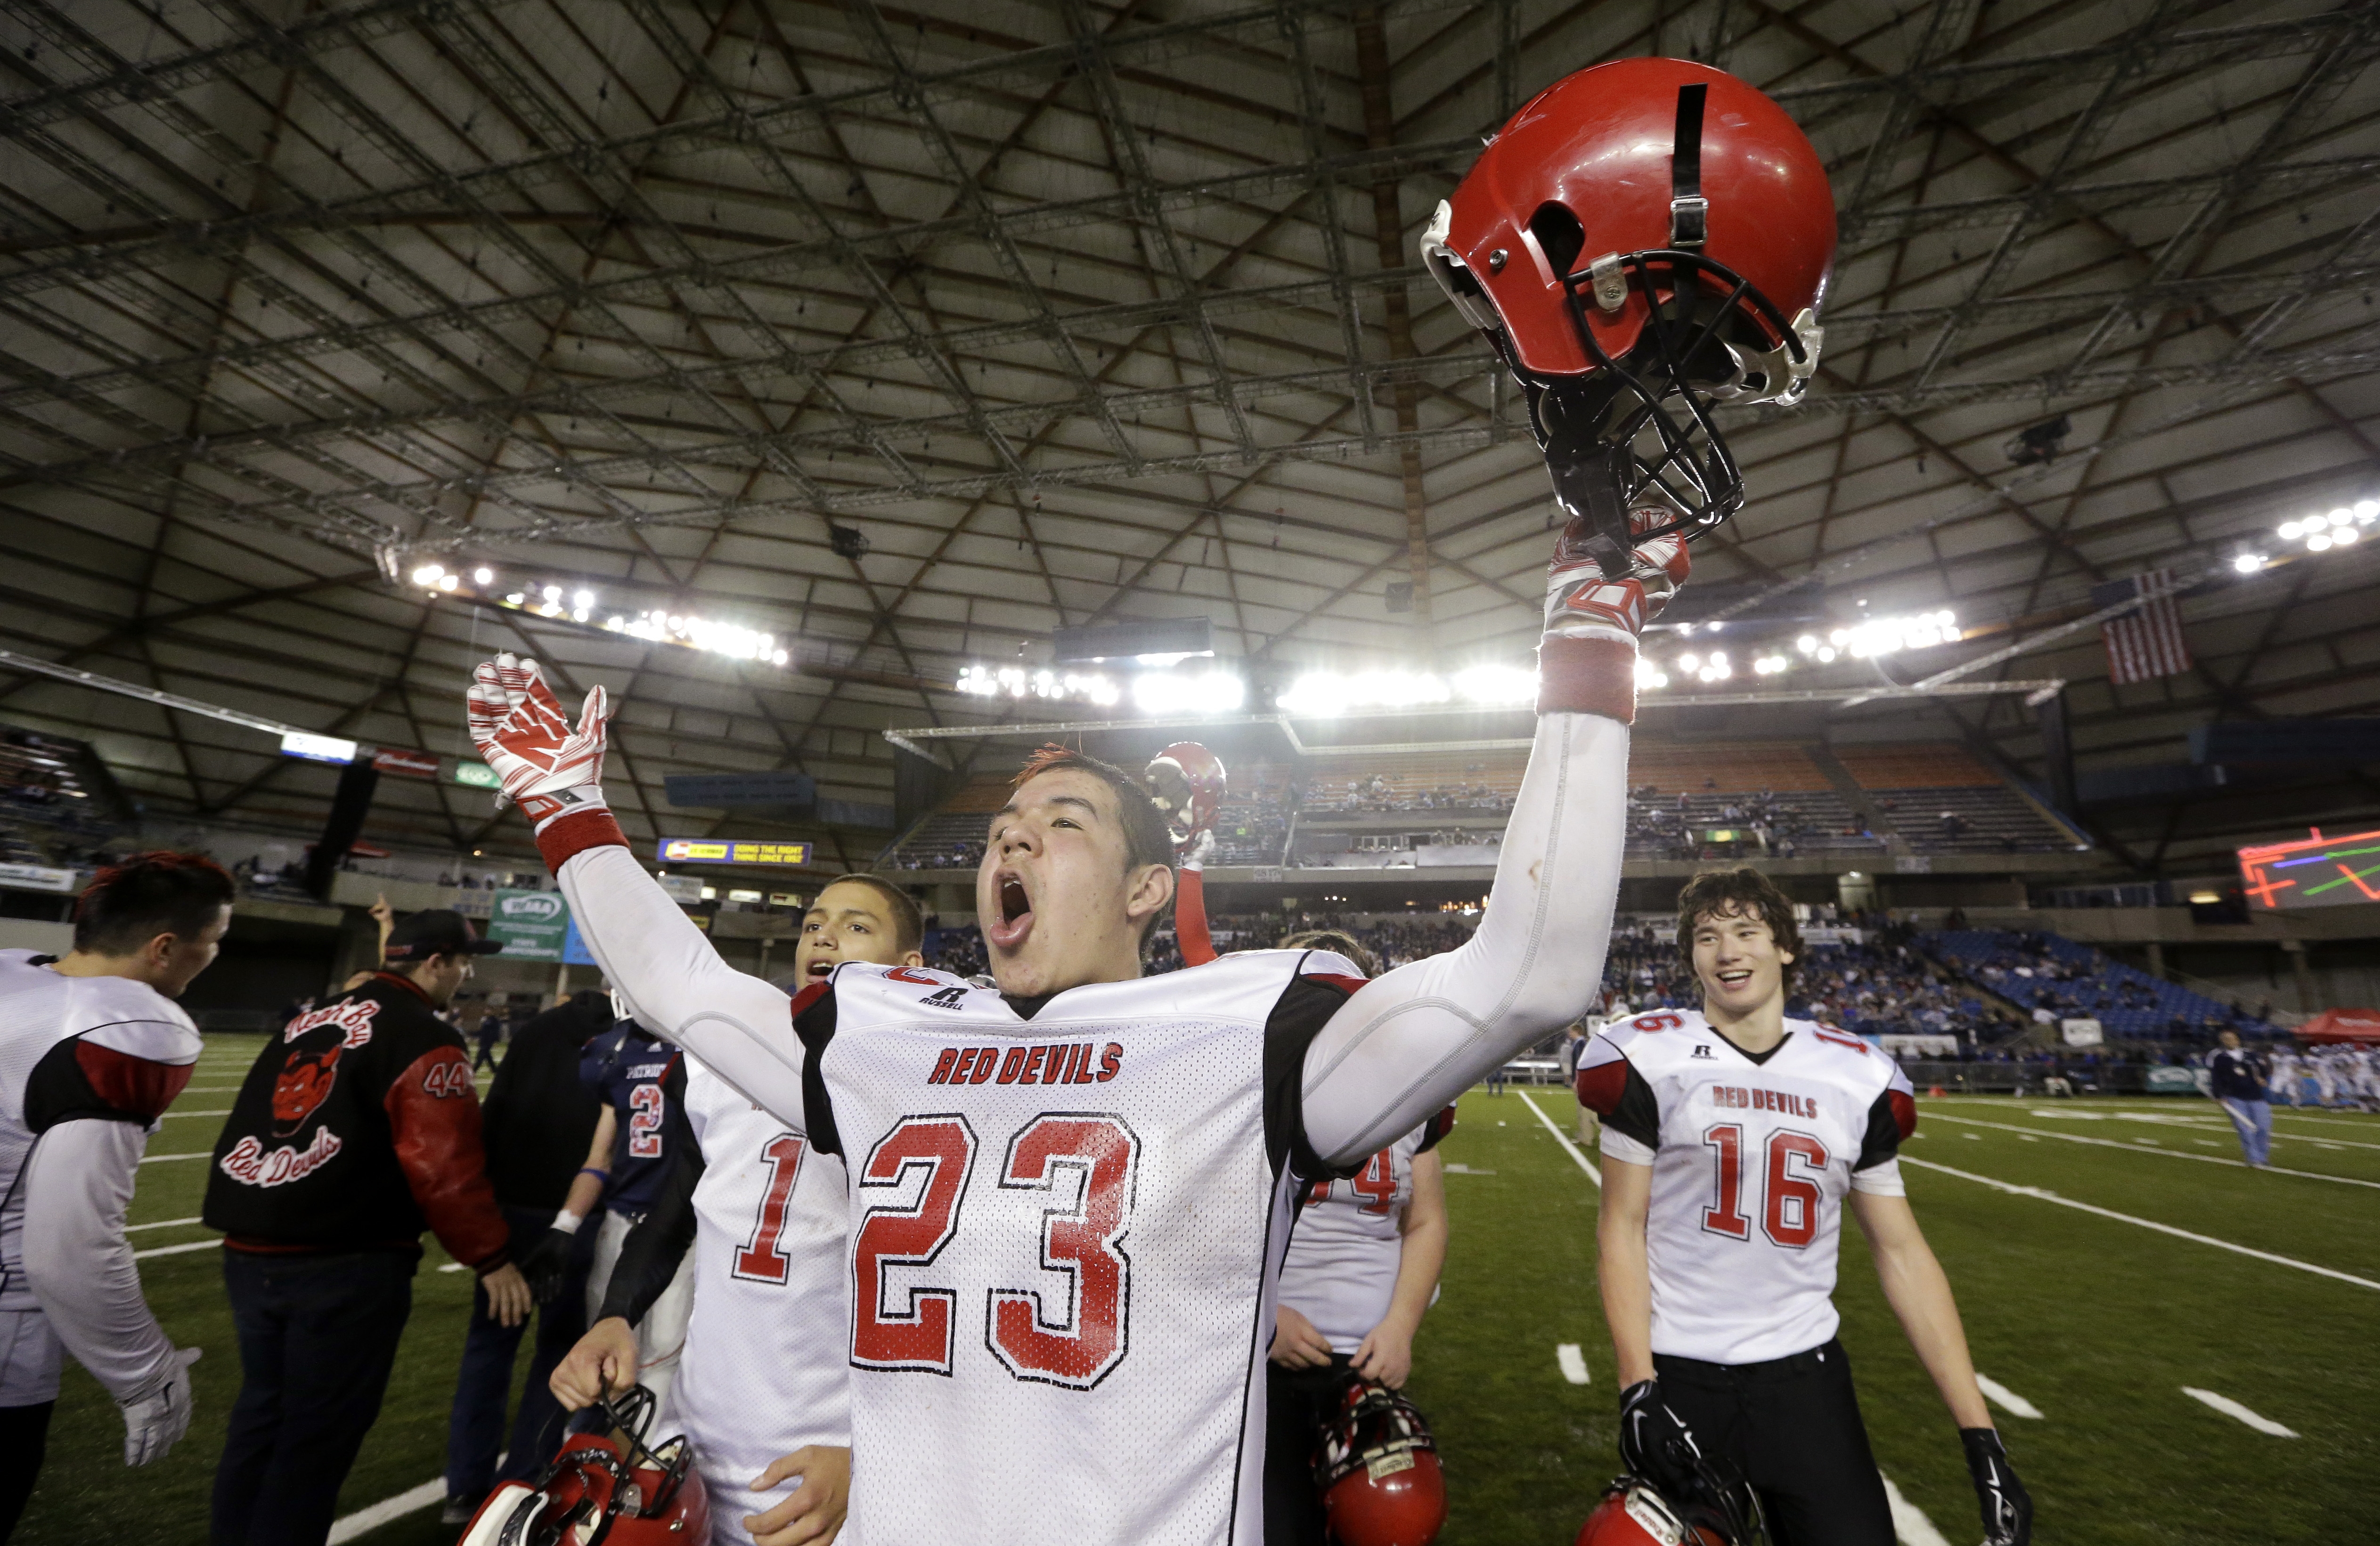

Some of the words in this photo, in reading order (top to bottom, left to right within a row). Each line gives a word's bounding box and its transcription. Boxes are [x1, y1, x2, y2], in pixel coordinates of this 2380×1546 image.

[919, 997, 964, 1010] RUSSELL
[424, 1062, 473, 1097] 44
[928, 1047, 999, 1085] RED
[995, 1042, 1124, 1085] DEVILS
[629, 1084, 664, 1158] 2
[1712, 1085, 1748, 1108] RED
[1752, 1088, 1818, 1119] DEVILS
[220, 1135, 274, 1185] Red
[262, 1125, 342, 1188] Devils
[1701, 1123, 1830, 1249] 16
[731, 1132, 809, 1286] 1
[849, 1111, 1142, 1392] 23
